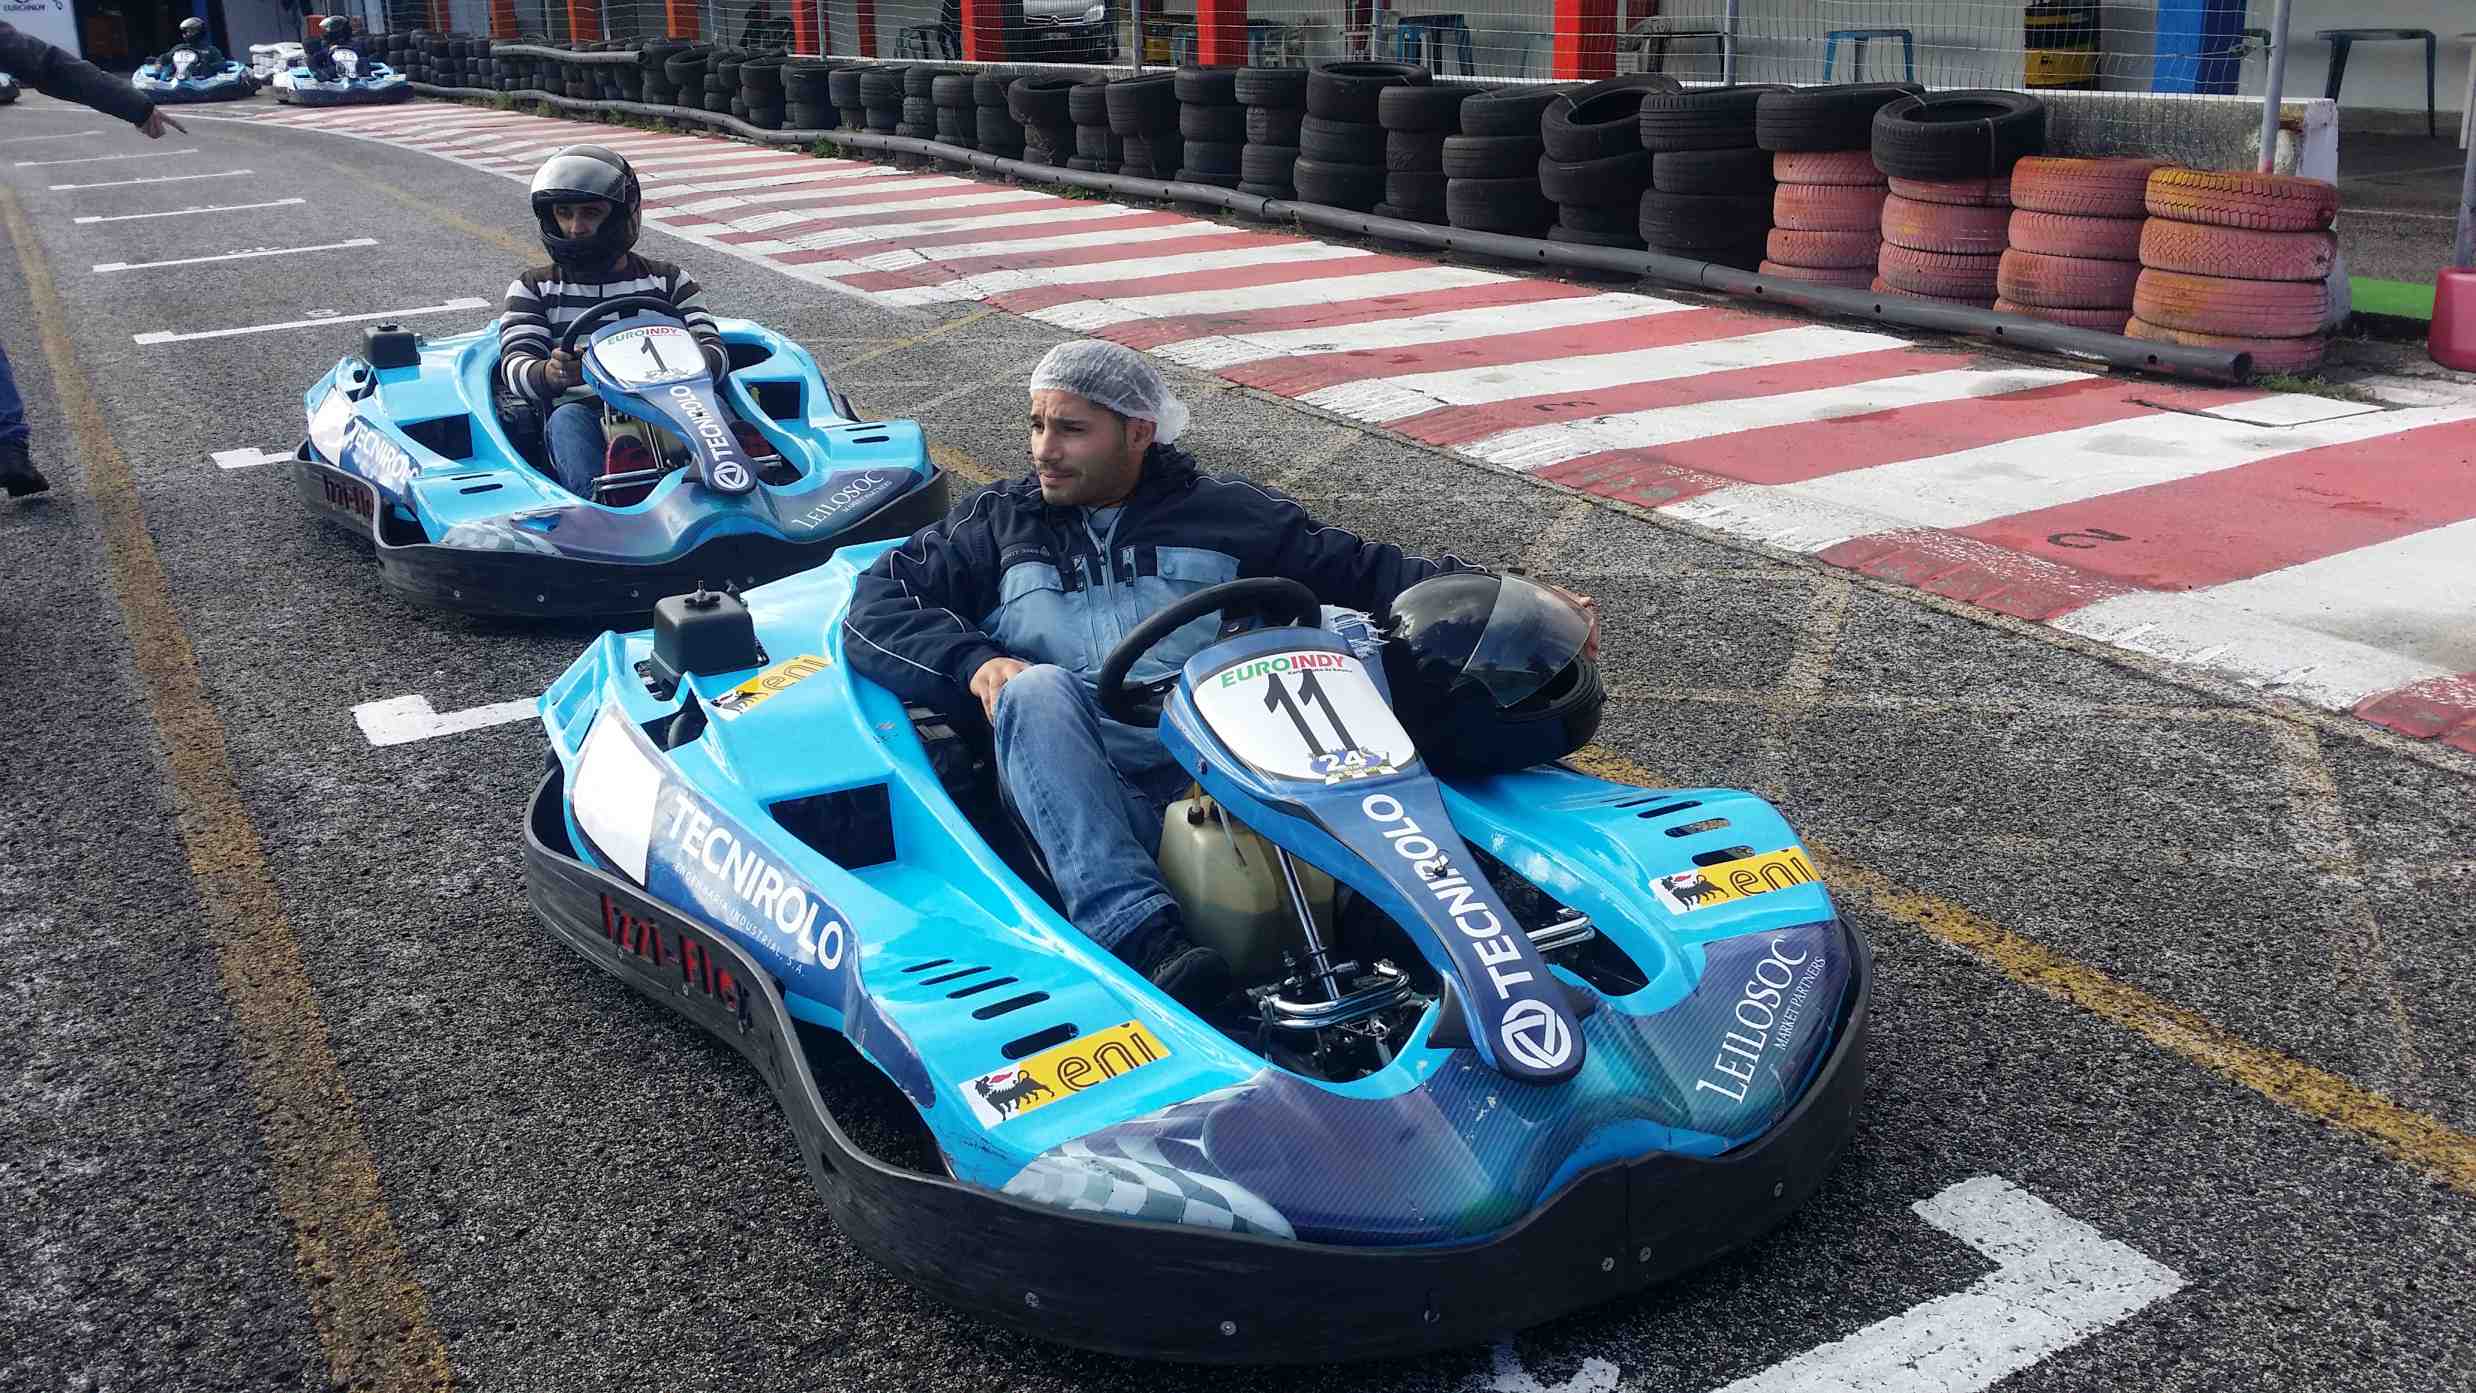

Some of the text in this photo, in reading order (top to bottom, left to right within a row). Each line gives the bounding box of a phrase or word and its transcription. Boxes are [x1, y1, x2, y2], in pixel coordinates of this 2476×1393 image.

[607, 327, 679, 345] EUROINDY
[641, 336, 667, 372] 1
[670, 385, 733, 461] TECNIROLO
[791, 470, 884, 529] LEILOSOC
[762, 655, 827, 690] eni
[1220, 654, 1344, 688] EUROINDY
[1263, 668, 1360, 755] 11
[1318, 750, 1367, 771] 24
[669, 794, 844, 971] TECNIROLO
[1361, 793, 1534, 1000] TECNIROLO
[1729, 848, 1816, 897] eni
[1695, 935, 1808, 1105] LEILOSOC
[1772, 955, 1827, 1052] MARKET PARTNERS
[1057, 1023, 1158, 1092] eni
